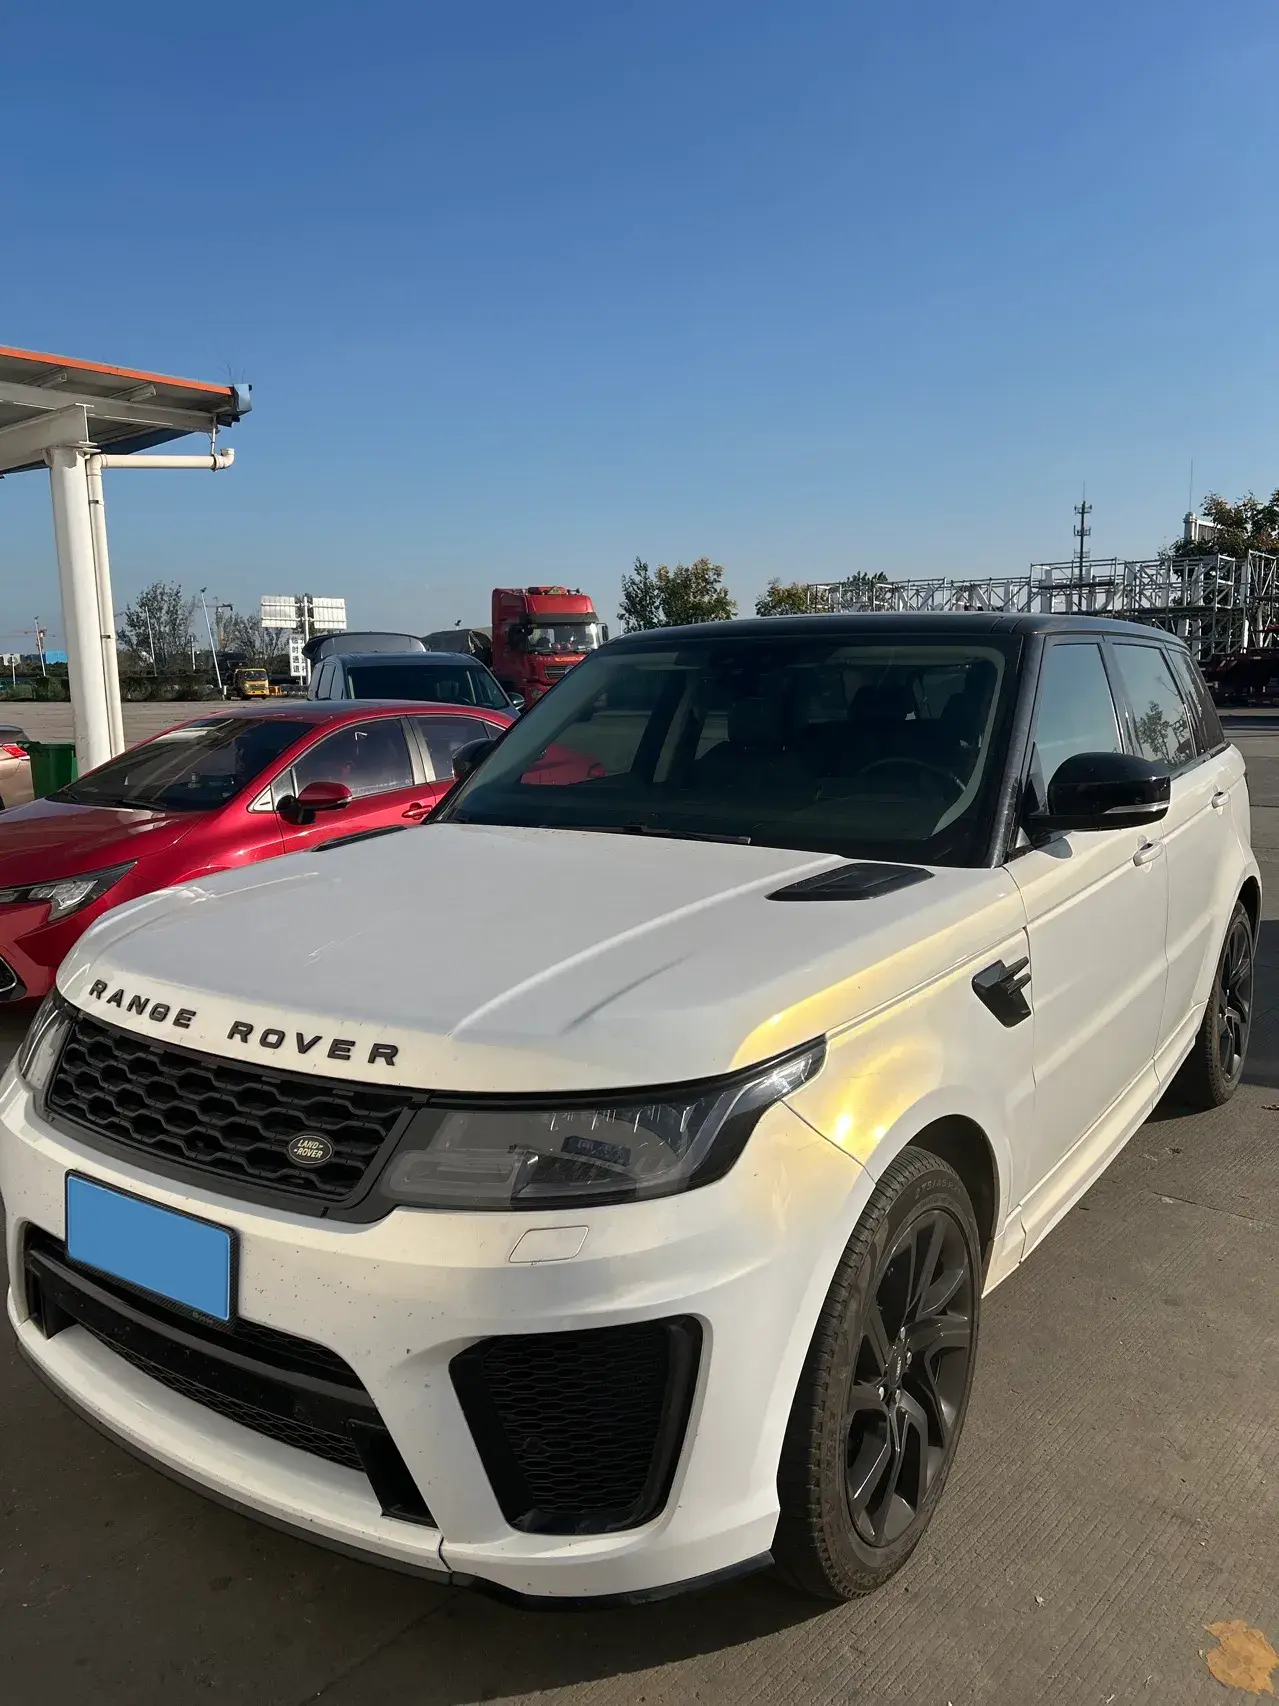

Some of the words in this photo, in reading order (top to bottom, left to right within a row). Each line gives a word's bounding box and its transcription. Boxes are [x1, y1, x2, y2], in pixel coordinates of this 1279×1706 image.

[88, 979, 197, 1029] RANGE
[227, 1020, 399, 1067] ROVER
[297, 1139, 319, 1149] LAND
[296, 1147, 323, 1158] ROVER
